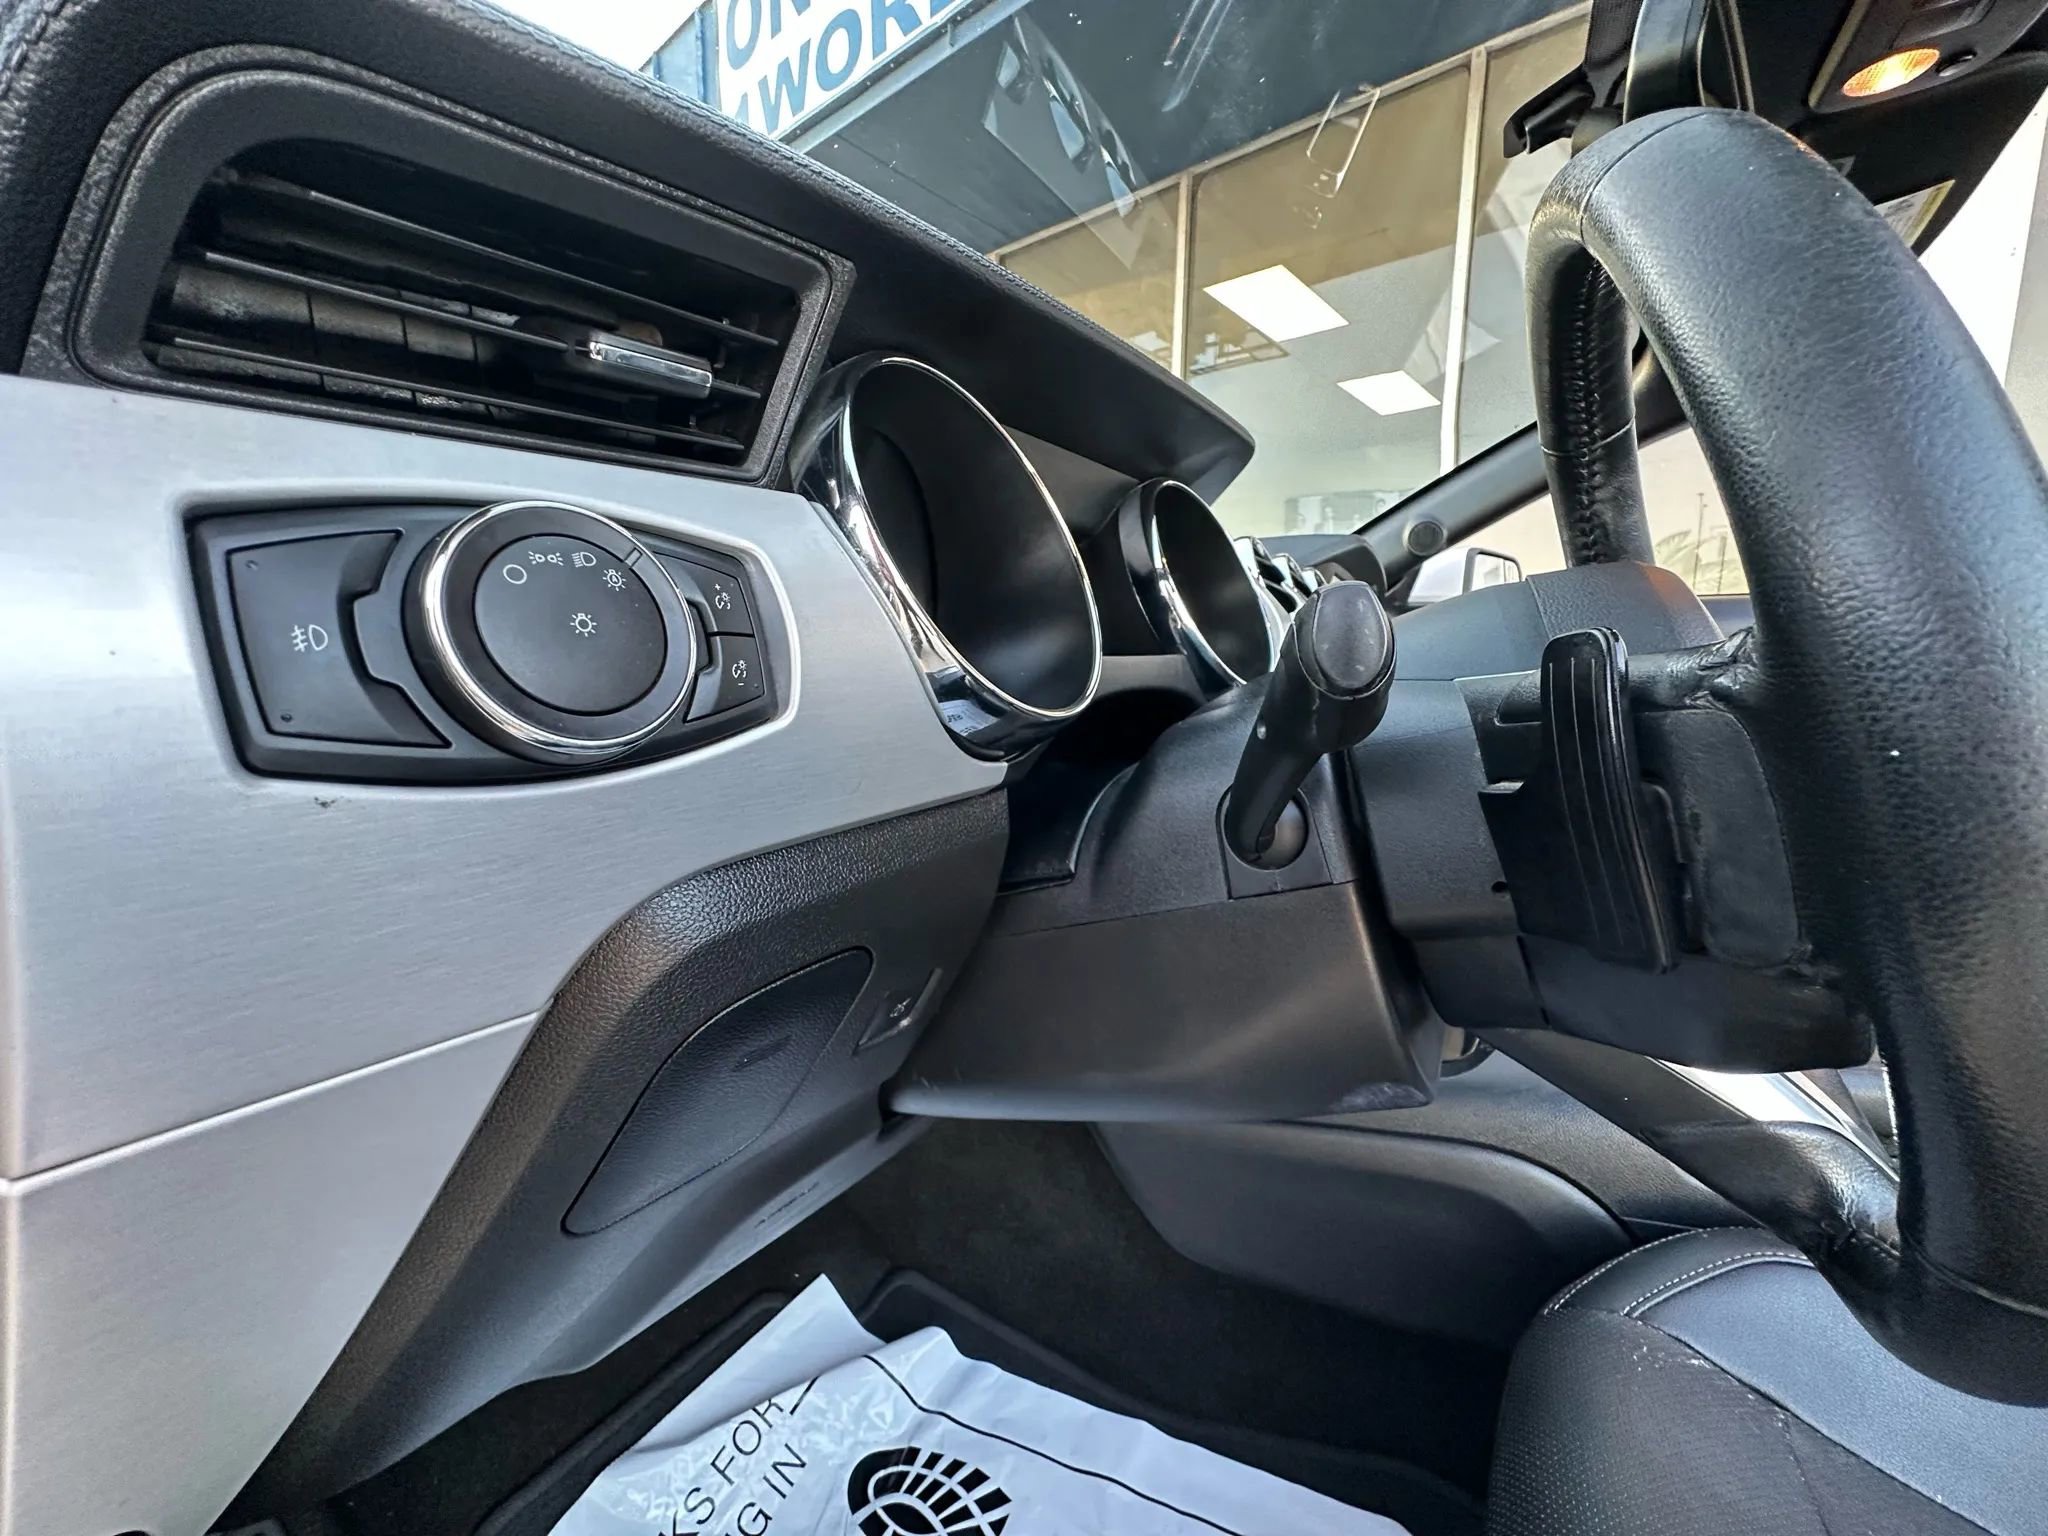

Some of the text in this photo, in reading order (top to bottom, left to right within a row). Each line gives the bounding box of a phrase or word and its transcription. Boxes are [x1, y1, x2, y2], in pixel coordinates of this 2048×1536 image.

[735, 0, 957, 135] WOR
[710, 1399, 784, 1486] FOR
[763, 1442, 807, 1500] IN
